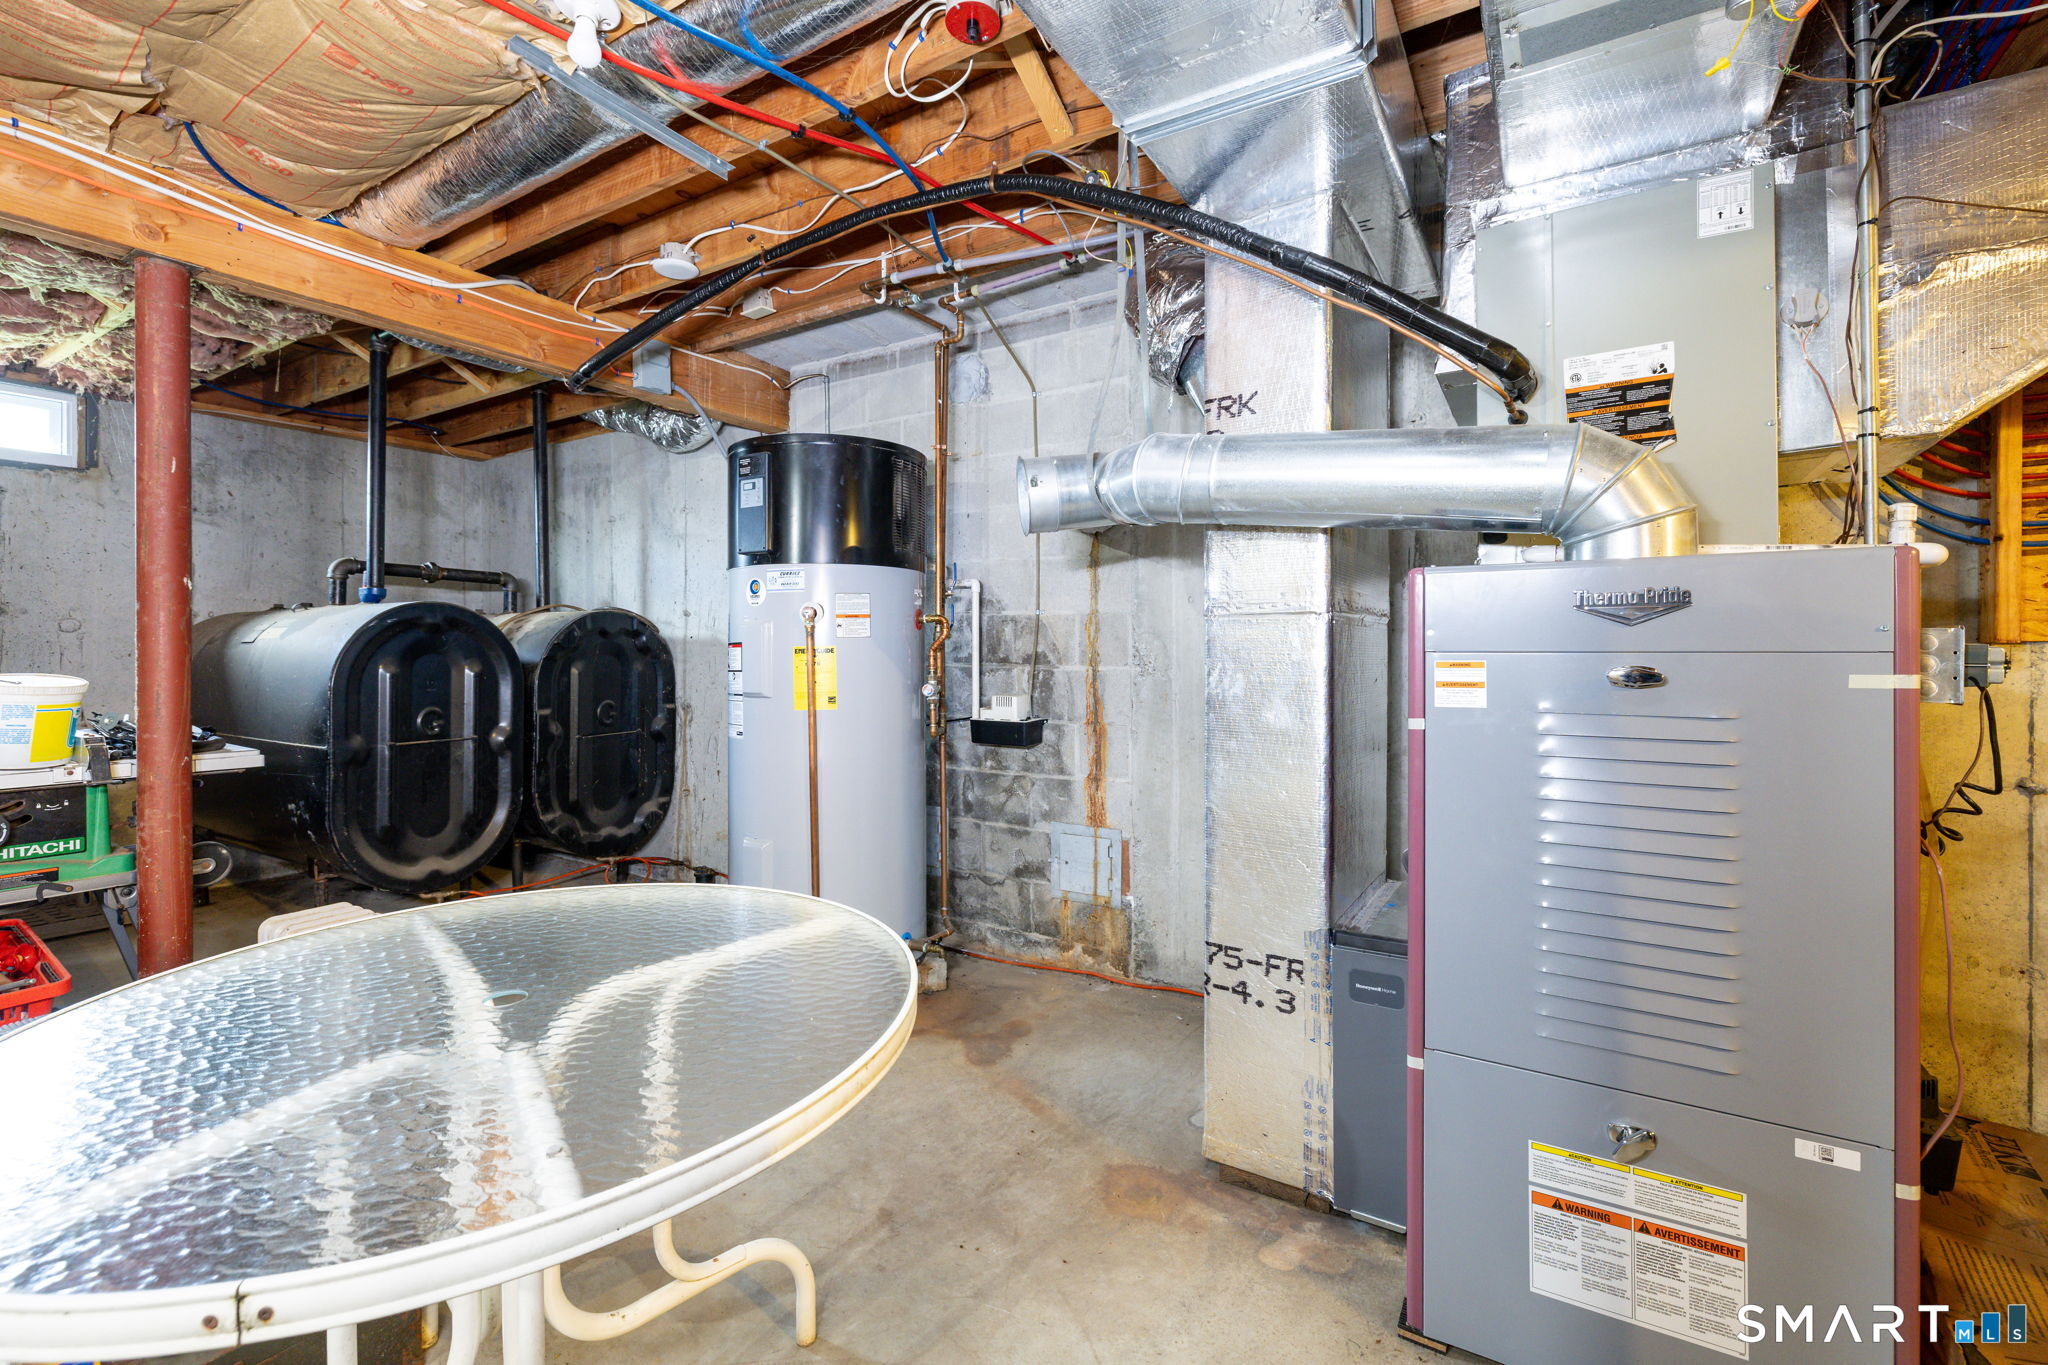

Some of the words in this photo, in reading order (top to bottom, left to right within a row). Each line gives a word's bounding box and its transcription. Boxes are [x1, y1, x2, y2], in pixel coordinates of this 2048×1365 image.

[1573, 589, 1638, 606] Thermo
[1643, 586, 1693, 605] Pride
[1355, 983, 1382, 992] Honeywell
[1675, 1179, 1704, 1190] ATTENTION
[1565, 1203, 1611, 1222] WARNING
[1654, 1228, 1741, 1258] AVERTISSEMENT
